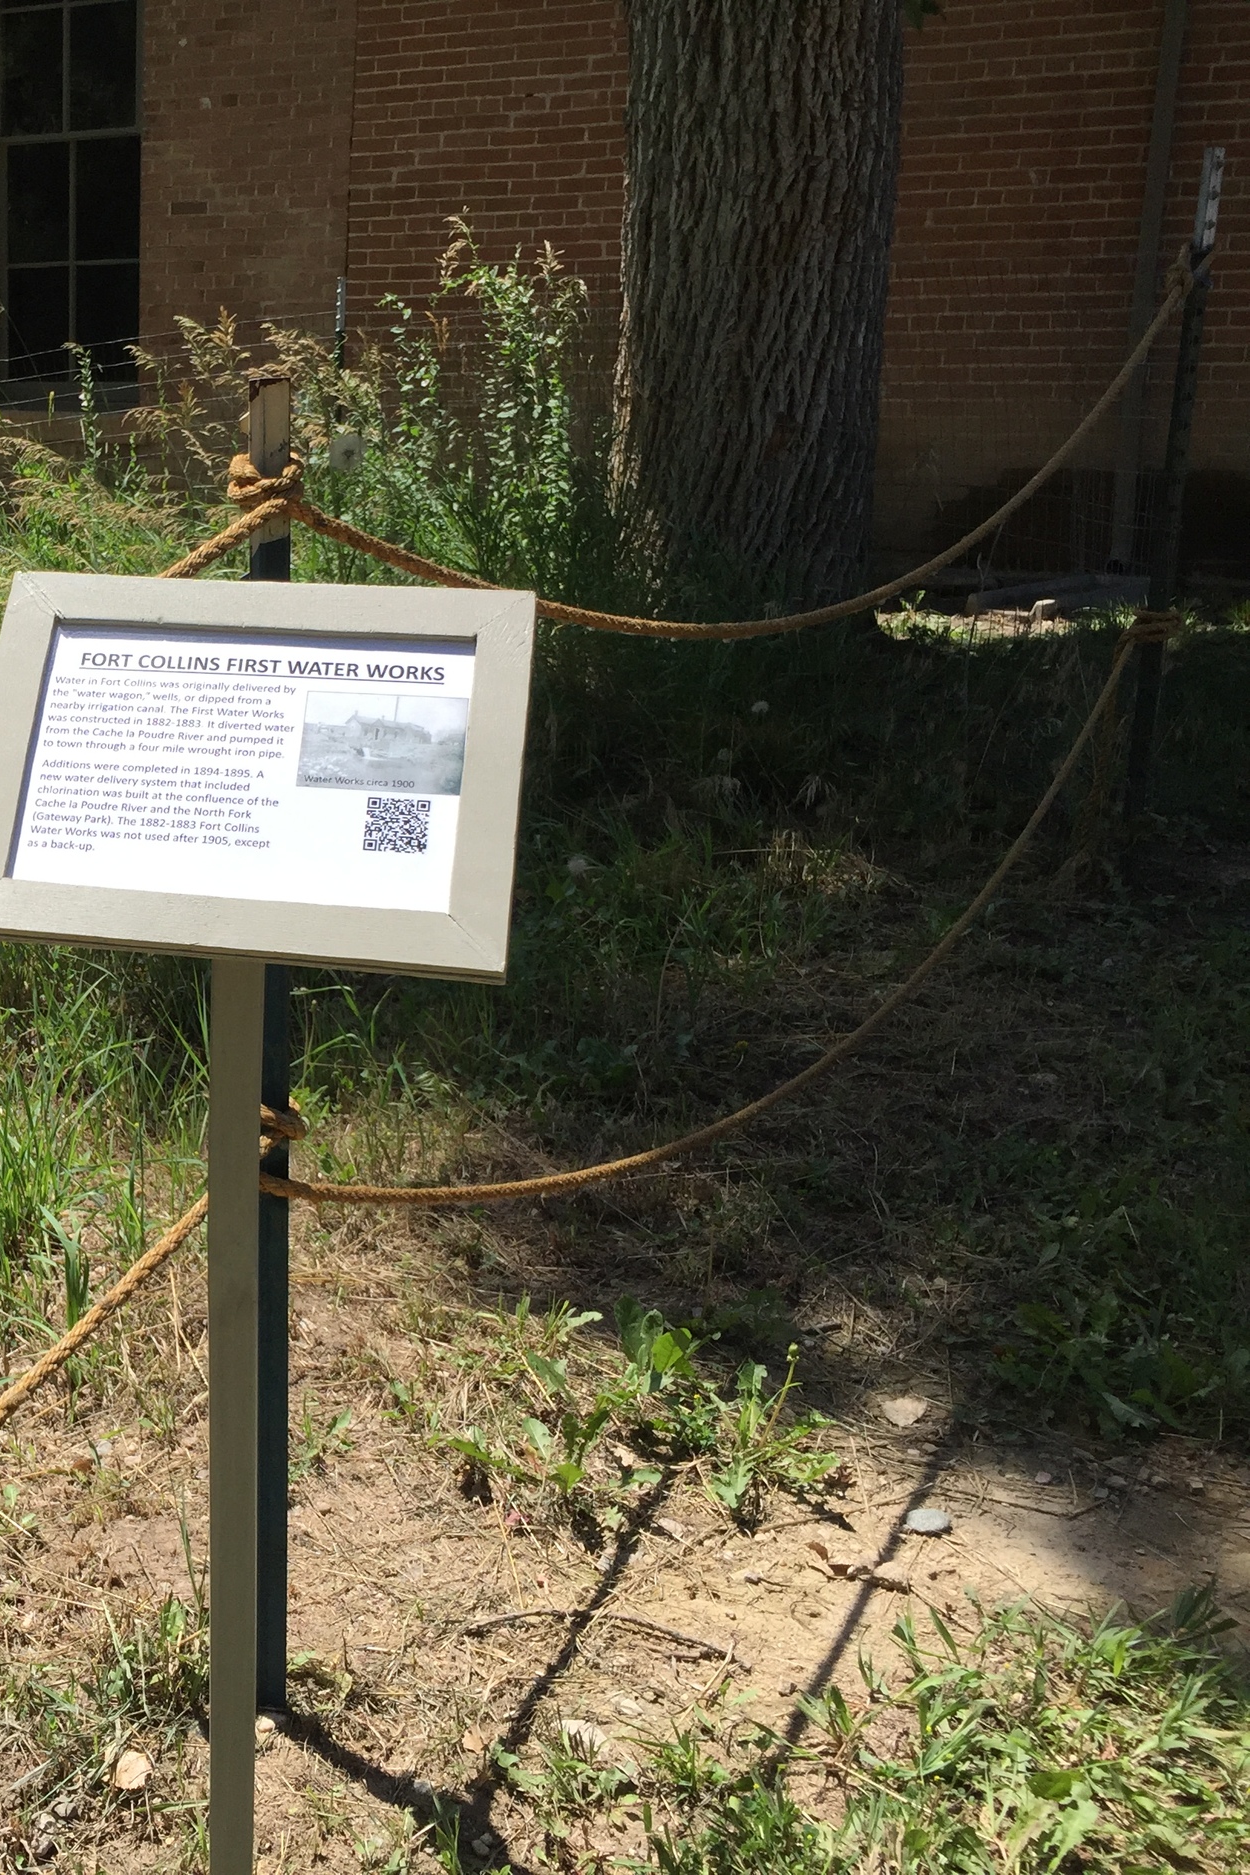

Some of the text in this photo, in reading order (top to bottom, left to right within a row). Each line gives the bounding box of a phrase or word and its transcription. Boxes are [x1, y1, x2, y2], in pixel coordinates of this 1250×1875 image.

[80, 652, 445, 680] FORT COLLINS FIRST WATER WORKS
[55, 676, 86, 684] Water
[100, 677, 121, 686] Fort
[123, 678, 157, 687] Collins
[182, 682, 231, 692] originally
[232, 682, 281, 693] delivered
[283, 684, 297, 695] by
[52, 687, 70, 696] the
[152, 692, 181, 701] wells,
[197, 694, 235, 704] dipped
[237, 696, 263, 704] from
[49, 701, 86, 711] nearby
[87, 702, 135, 712] irrigation
[170, 705, 189, 714] The
[191, 706, 214, 715] First
[216, 708, 250, 717] Water
[251, 709, 285, 719] Works
[69, 715, 131, 724] constructed
[133, 716, 143, 724] in
[146, 717, 205, 727] 1882-1883.
[207, 720, 216, 728] It
[217, 721, 262, 730] diverted
[264, 724, 295, 732] water
[45, 725, 284, 745] from the Cache la Poudre River and pumped it
[56, 739, 83, 747] town
[85, 740, 127, 751] through
[138, 742, 160, 751] four
[162, 744, 185, 753] mile
[187, 747, 232, 757] wrought
[234, 748, 256, 756] iron
[257, 749, 286, 759] pipe.
[41, 759, 91, 769] Additions
[122, 763, 179, 774] completed
[180, 765, 191, 774] in
[193, 766, 253, 778] 1894-1895.
[255, 770, 265, 778] A
[64, 774, 95, 782] water
[96, 774, 139, 786] delivery
[140, 778, 178, 787] system
[180, 779, 202, 788] that
[204, 780, 251, 791] included
[303, 774, 416, 788] Water Works circa 1900
[37, 784, 280, 807] chlorination was built at the confluence of the
[34, 798, 252, 819] Cache la Poudre River and the North Fork
[32, 811, 260, 833] (Gateway Park). The 1882-1883 Fort Collins
[26, 839, 39, 847] as
[50, 839, 95, 852] back-up.
[30, 824, 271, 849] Water Works was not used after 1905, except
